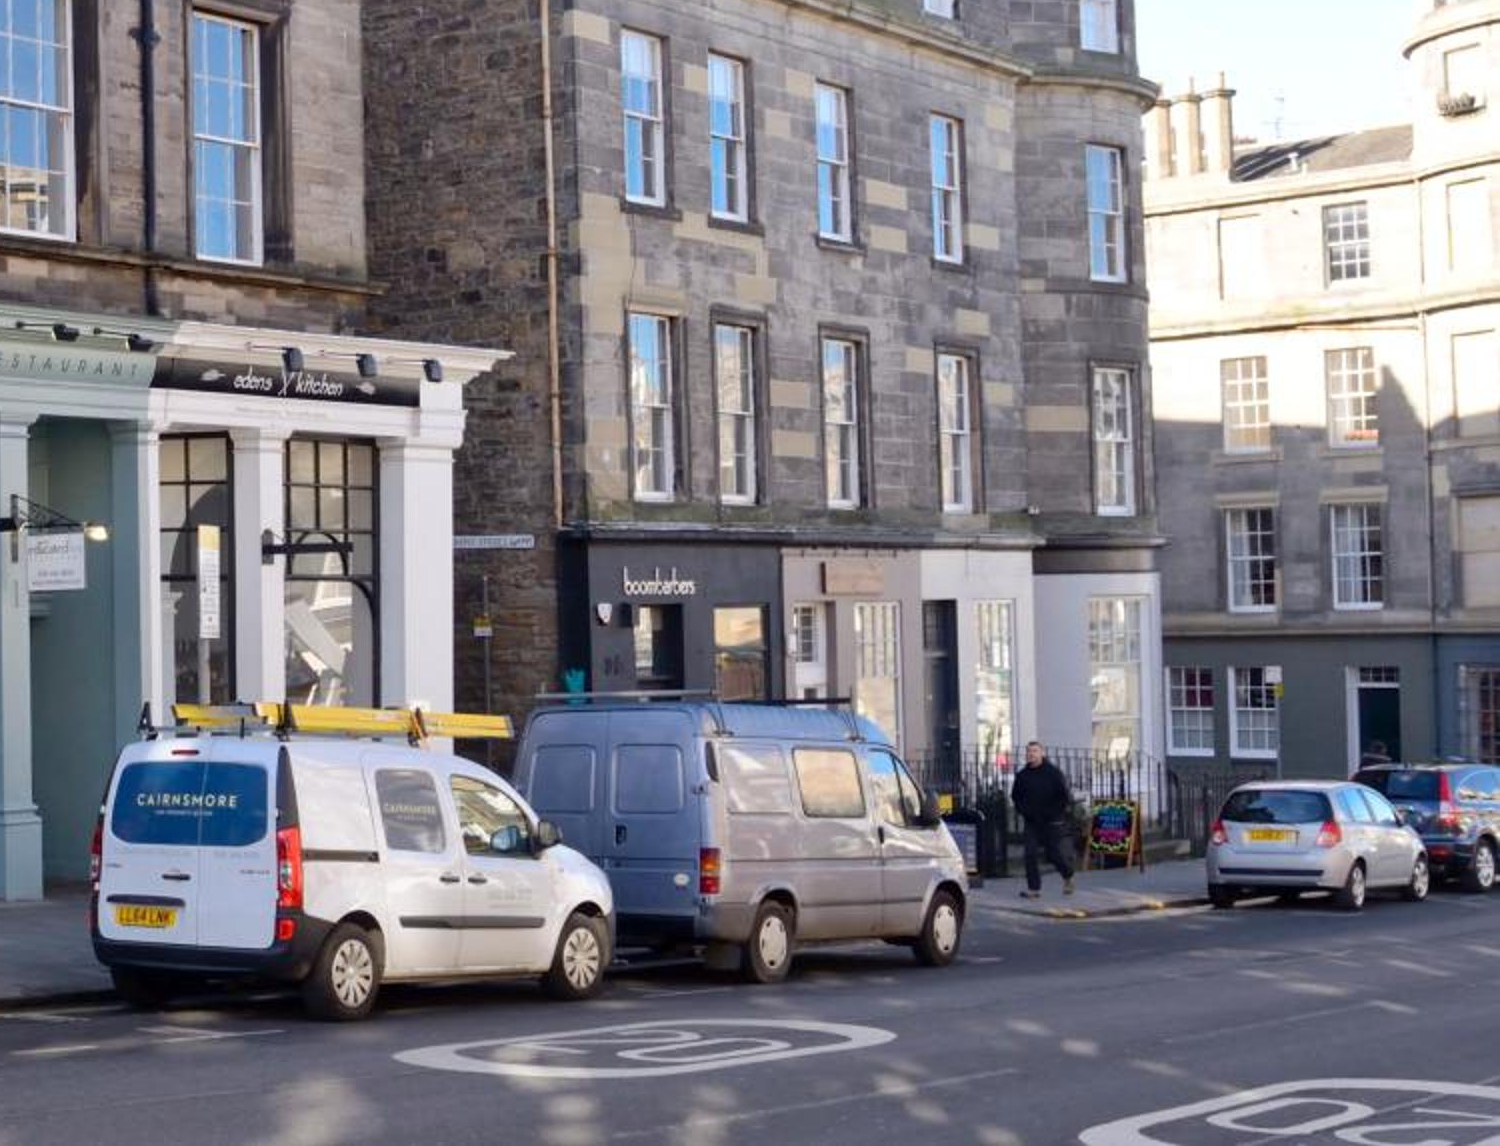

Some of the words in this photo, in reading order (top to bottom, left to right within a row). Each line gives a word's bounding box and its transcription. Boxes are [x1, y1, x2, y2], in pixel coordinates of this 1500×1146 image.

[295, 371, 343, 396] kitchen
[623, 565, 696, 596] boombarbers
[137, 793, 238, 809] CAIRNSMORE
